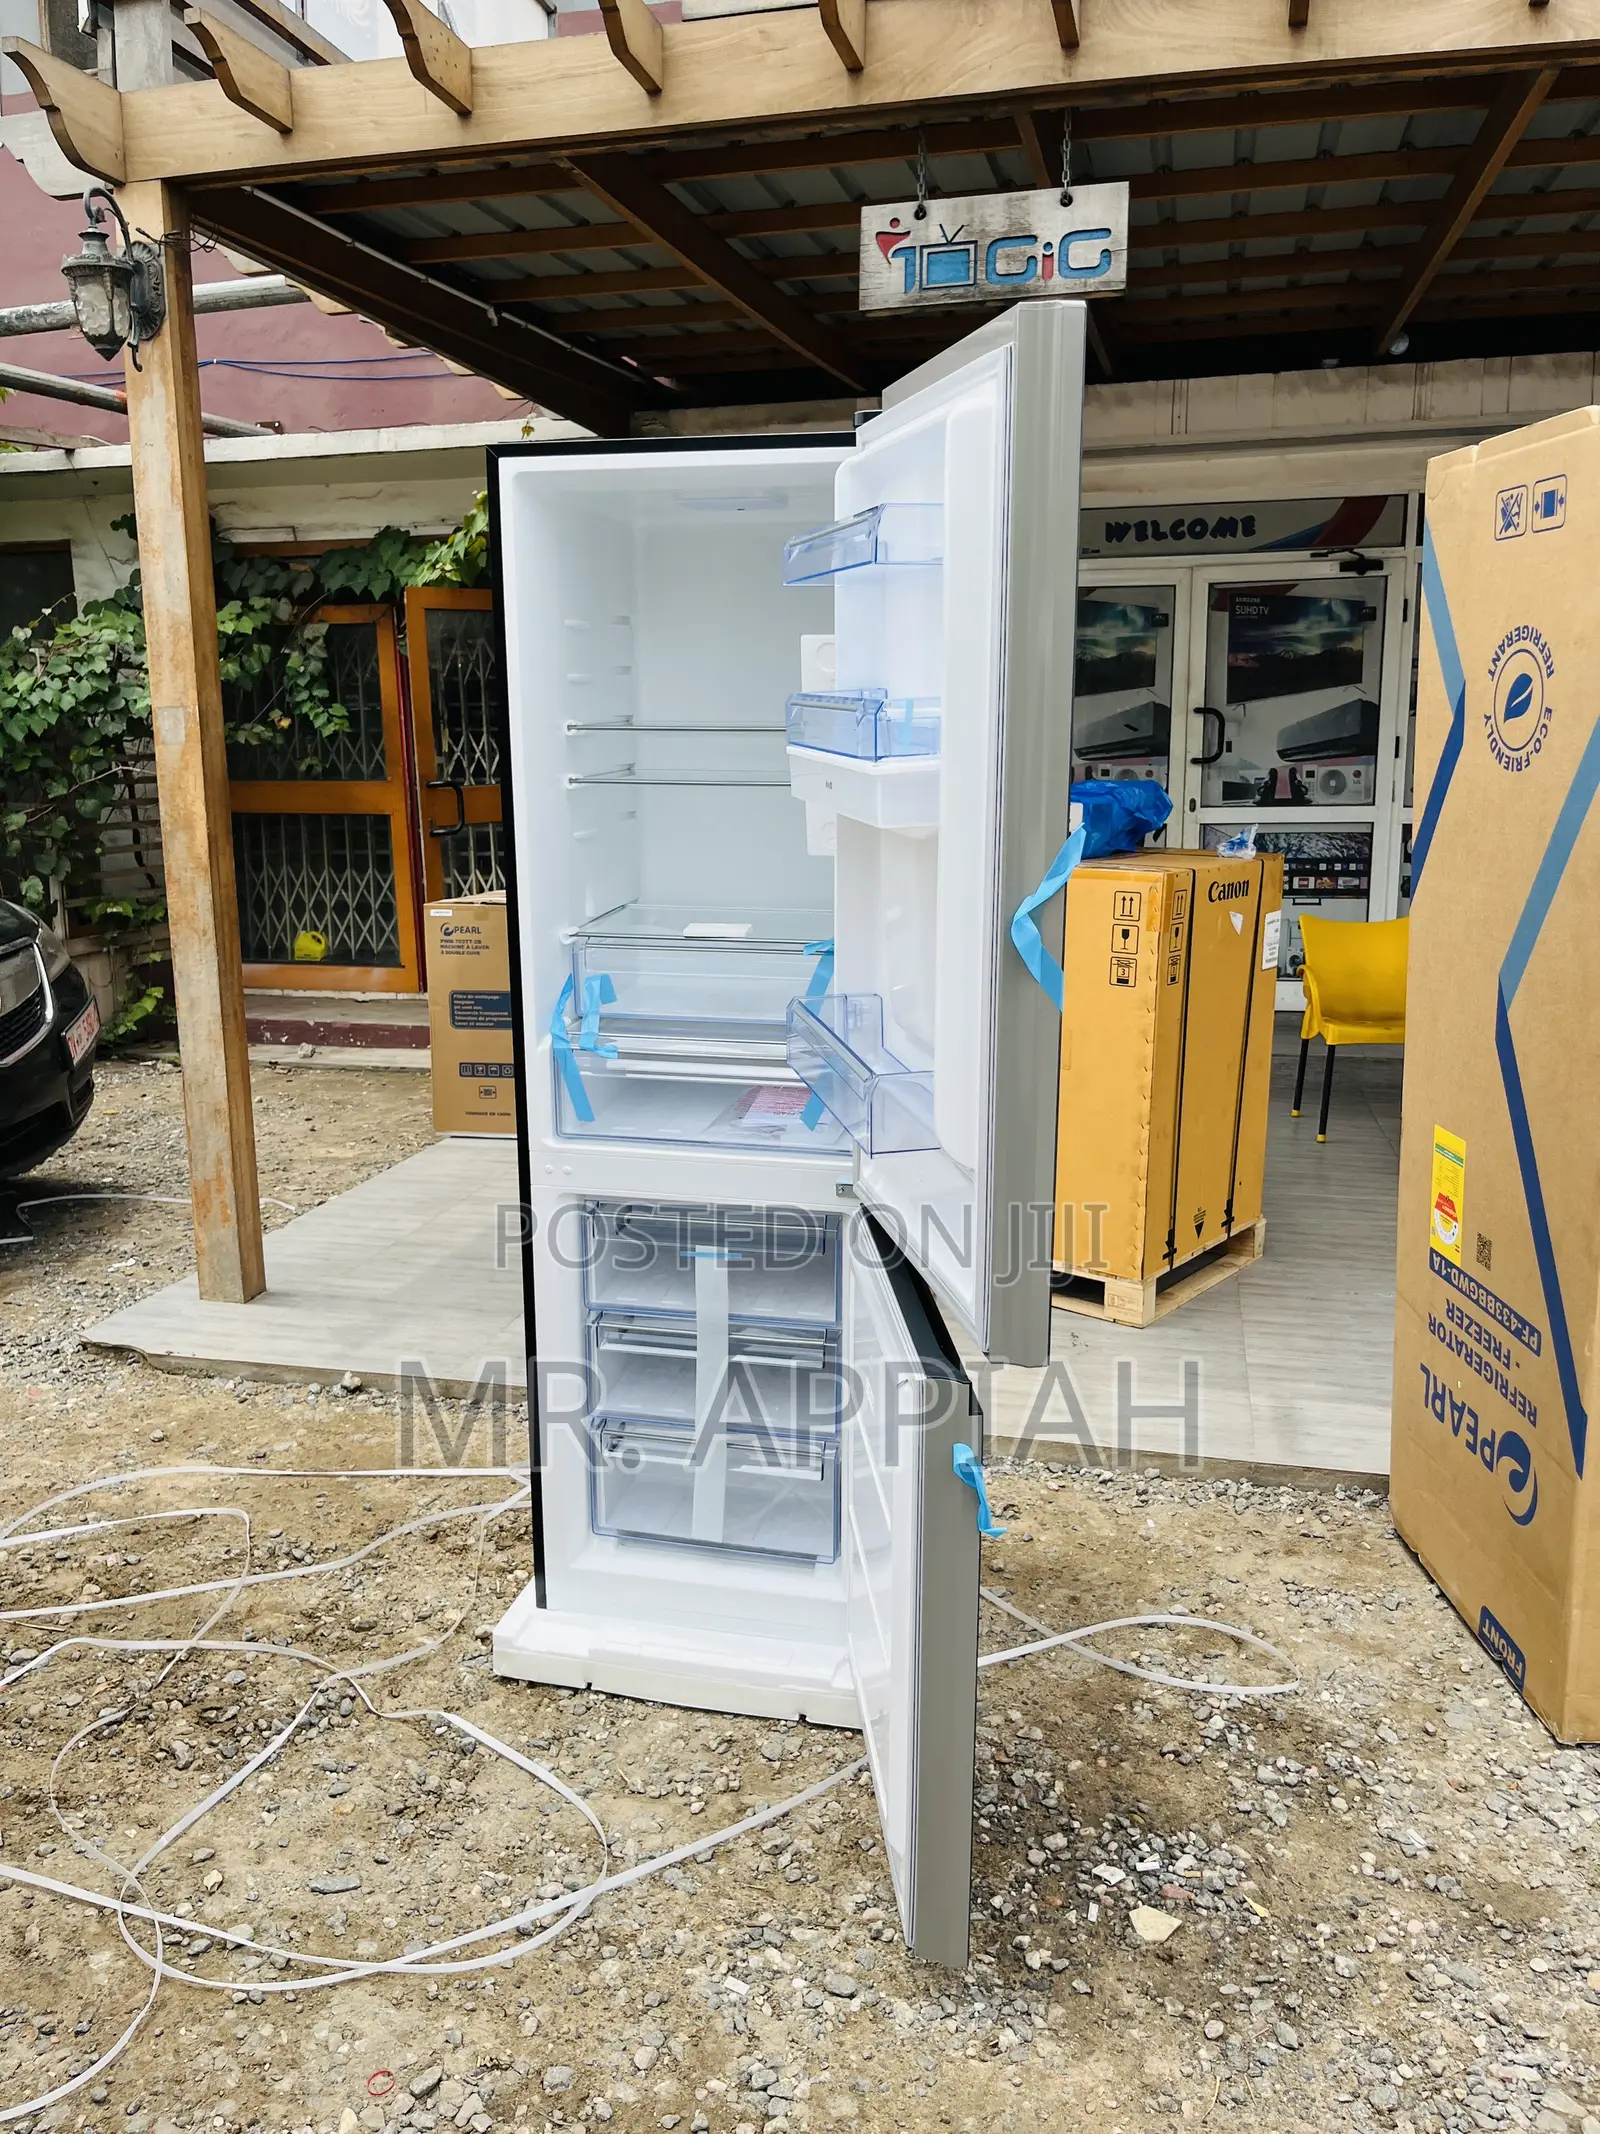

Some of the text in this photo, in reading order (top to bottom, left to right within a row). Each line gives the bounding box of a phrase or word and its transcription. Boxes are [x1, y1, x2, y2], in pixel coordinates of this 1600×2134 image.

[1105, 515, 1256, 543] WELCOME
[1488, 625, 1554, 681] REFRIGERANT
[1484, 706, 1553, 772] ECO-FRIENDLY
[1208, 879, 1249, 903] Canon
[454, 926, 482, 934] PEARL
[1433, 1252, 1538, 1351] PF-433BBGWD-1A
[1446, 1297, 1511, 1371] FREEZER
[1427, 1311, 1538, 1429] REFRIGERATOR
[1420, 1362, 1496, 1474] PEARL
[1482, 1618, 1524, 1680] FRONT
